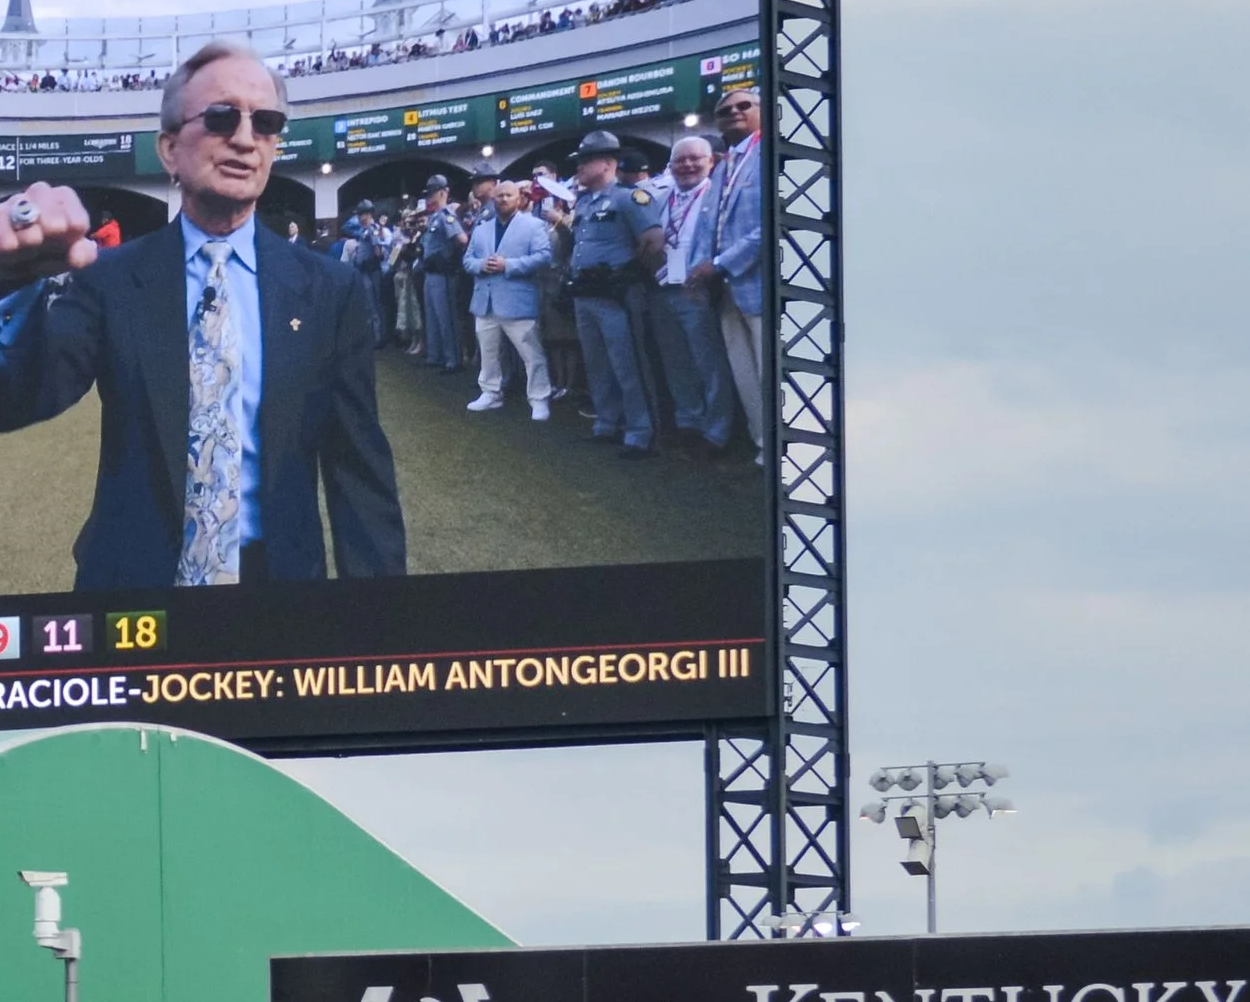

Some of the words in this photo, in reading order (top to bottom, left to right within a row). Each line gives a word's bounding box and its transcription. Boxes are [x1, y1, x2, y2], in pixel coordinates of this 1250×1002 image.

[510, 86, 576, 103] COMMANDMENT
[584, 85, 591, 95] 7
[418, 107, 447, 118] LITMUS
[448, 104, 468, 114] TEST
[347, 116, 389, 127] INTREPIDO
[38, 142, 60, 150] MILES
[19, 158, 34, 166] FOR
[42, 619, 83, 652] 11
[114, 616, 157, 649] 18
[293, 662, 436, 696] WILLIAM
[444, 650, 707, 689] ANTONGEORGI
[718, 648, 749, 677] III
